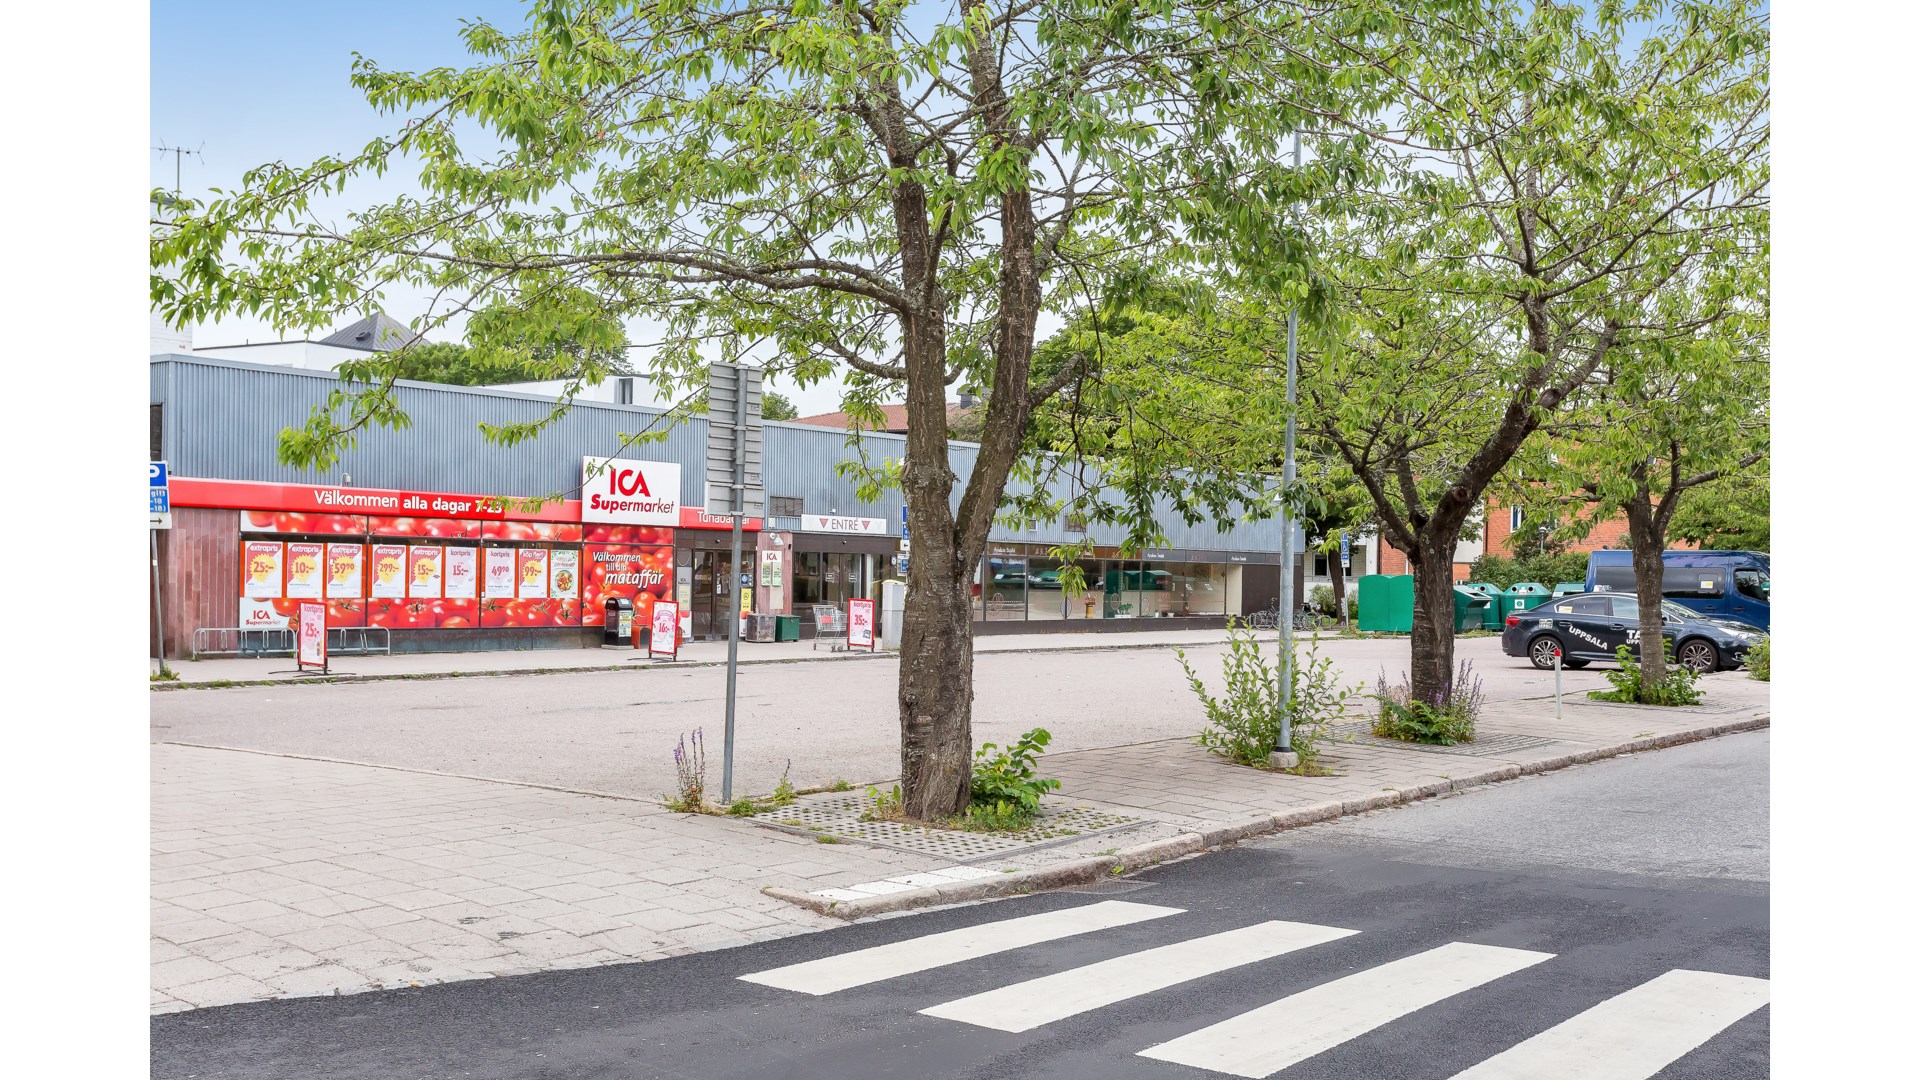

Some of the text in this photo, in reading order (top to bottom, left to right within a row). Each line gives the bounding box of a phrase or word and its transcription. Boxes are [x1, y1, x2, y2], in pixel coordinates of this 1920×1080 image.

[610, 468, 651, 497] ICA
[314, 489, 399, 508] Välkommen
[403, 496, 428, 509] alla
[432, 497, 471, 515] dagar
[590, 494, 675, 514] Supermarket
[831, 517, 858, 531] ENTRÉ
[332, 546, 358, 554] extrapris
[377, 547, 402, 555] extrapris
[450, 549, 471, 557] kortpris
[592, 552, 641, 562] Välkommen
[253, 561, 274, 573] 25:-
[295, 562, 314, 573] 10:-
[606, 563, 627, 571] till din
[604, 569, 664, 588] mataffär
[253, 610, 271, 620] ICA
[1568, 625, 1608, 650] UPPSALA
[1626, 630, 1641, 640] TA
